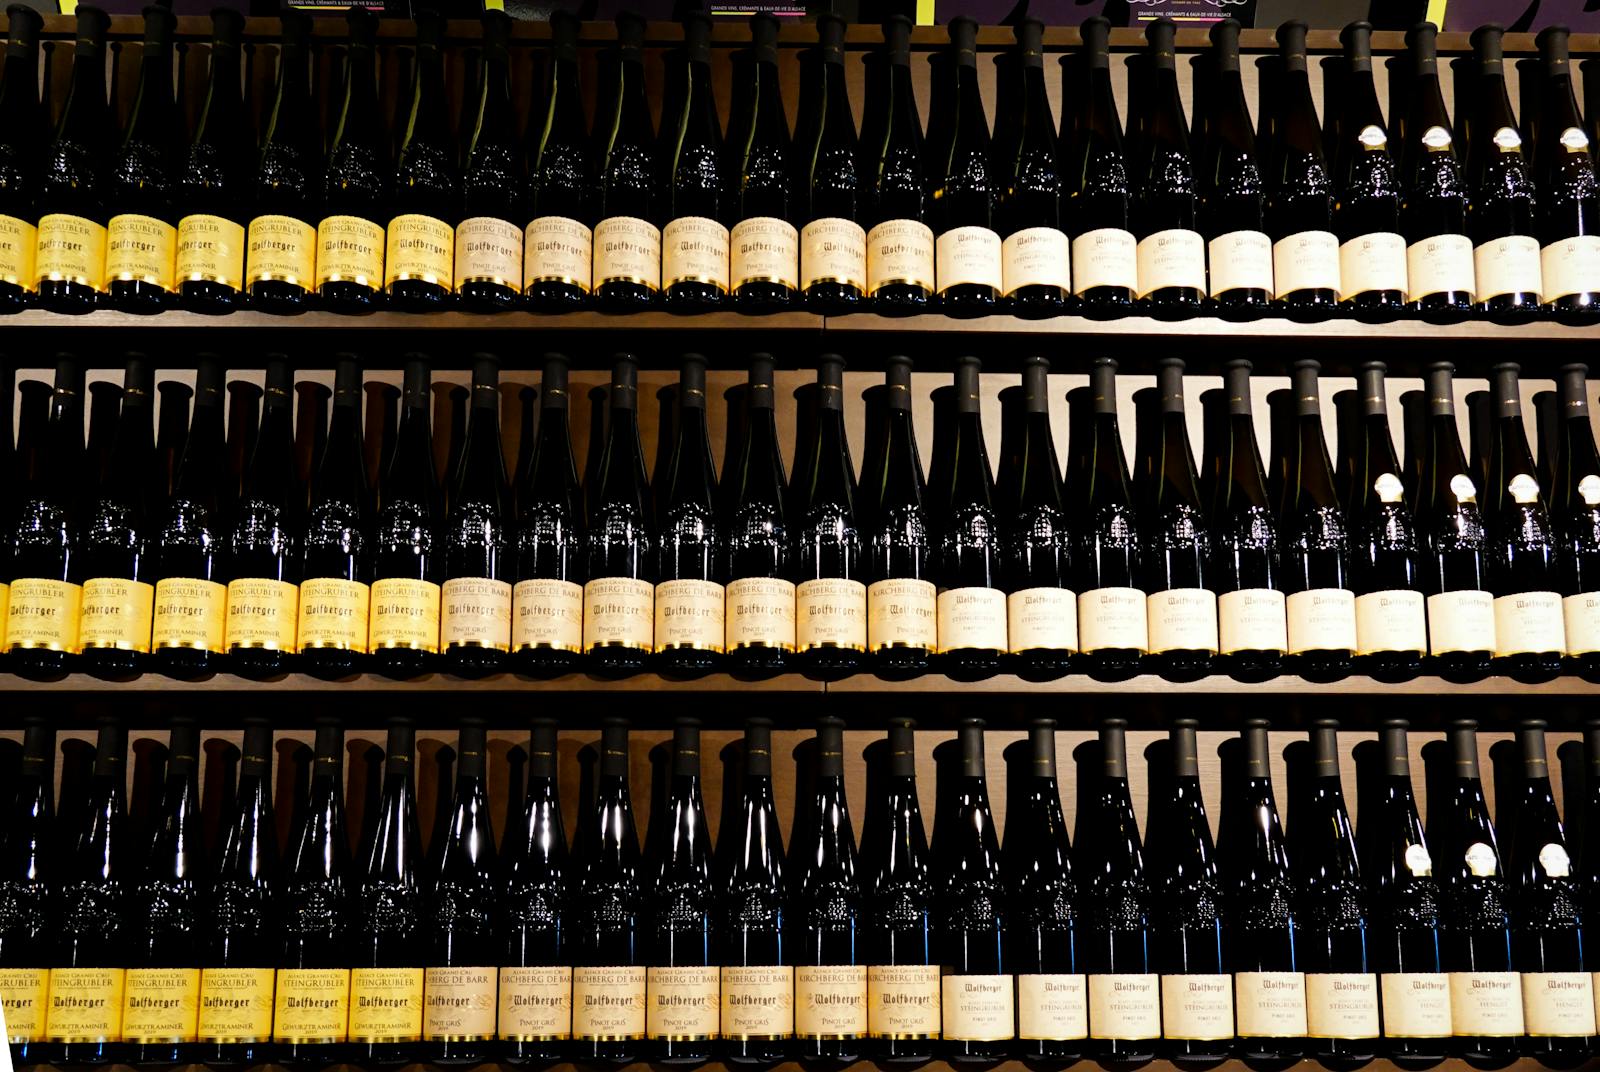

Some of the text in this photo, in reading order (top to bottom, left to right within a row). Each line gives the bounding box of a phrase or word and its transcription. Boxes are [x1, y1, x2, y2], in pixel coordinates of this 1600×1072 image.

[965, 984, 1002, 992] Wolfberger
[1472, 979, 1511, 989] Wolfberger
[1547, 980, 1585, 989] Wolfberger
[287, 997, 339, 1009] Wolfberger
[359, 996, 408, 1008] Wolfberger
[514, 995, 562, 1006] Wolfberger
[585, 995, 632, 1006] Wolfberger
[658, 995, 705, 1006] Wolfberger
[729, 994, 776, 1006] Wolfberger
[815, 994, 860, 1005] Wolfberger
[882, 993, 930, 1005] Wolfberger
